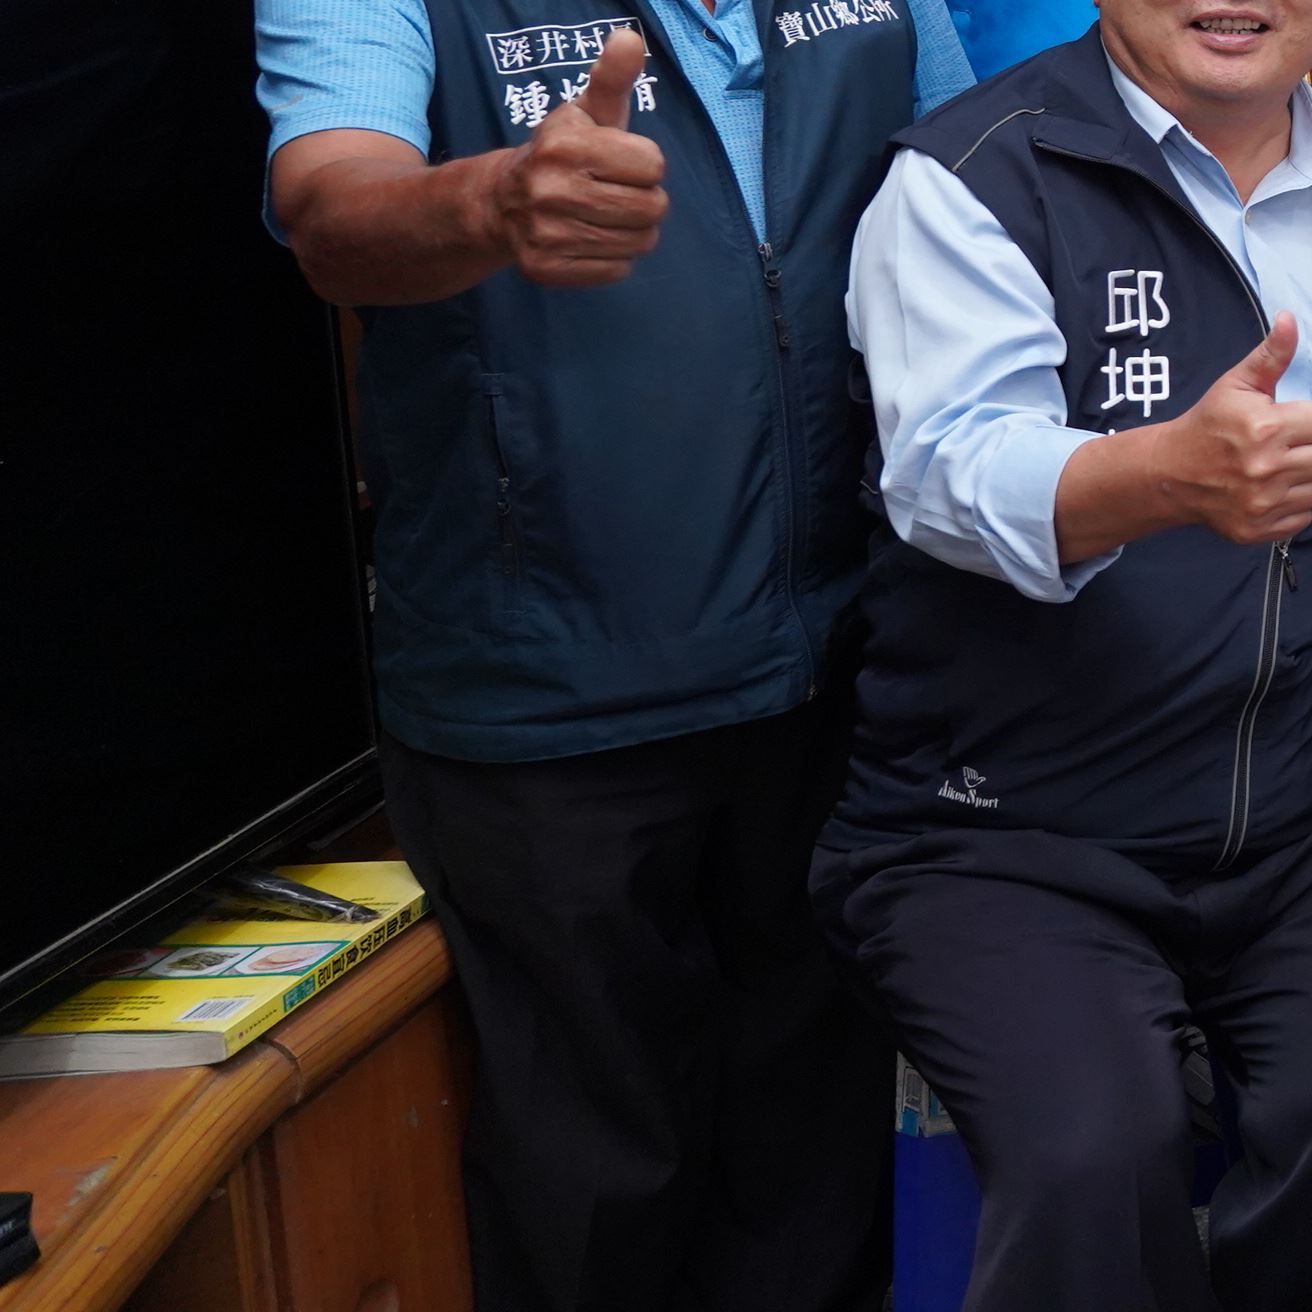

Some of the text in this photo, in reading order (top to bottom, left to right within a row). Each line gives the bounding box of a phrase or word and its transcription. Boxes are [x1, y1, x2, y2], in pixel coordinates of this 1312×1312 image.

[498, 20, 634, 69] 深井村
[1101, 269, 1170, 435] 邱坤
